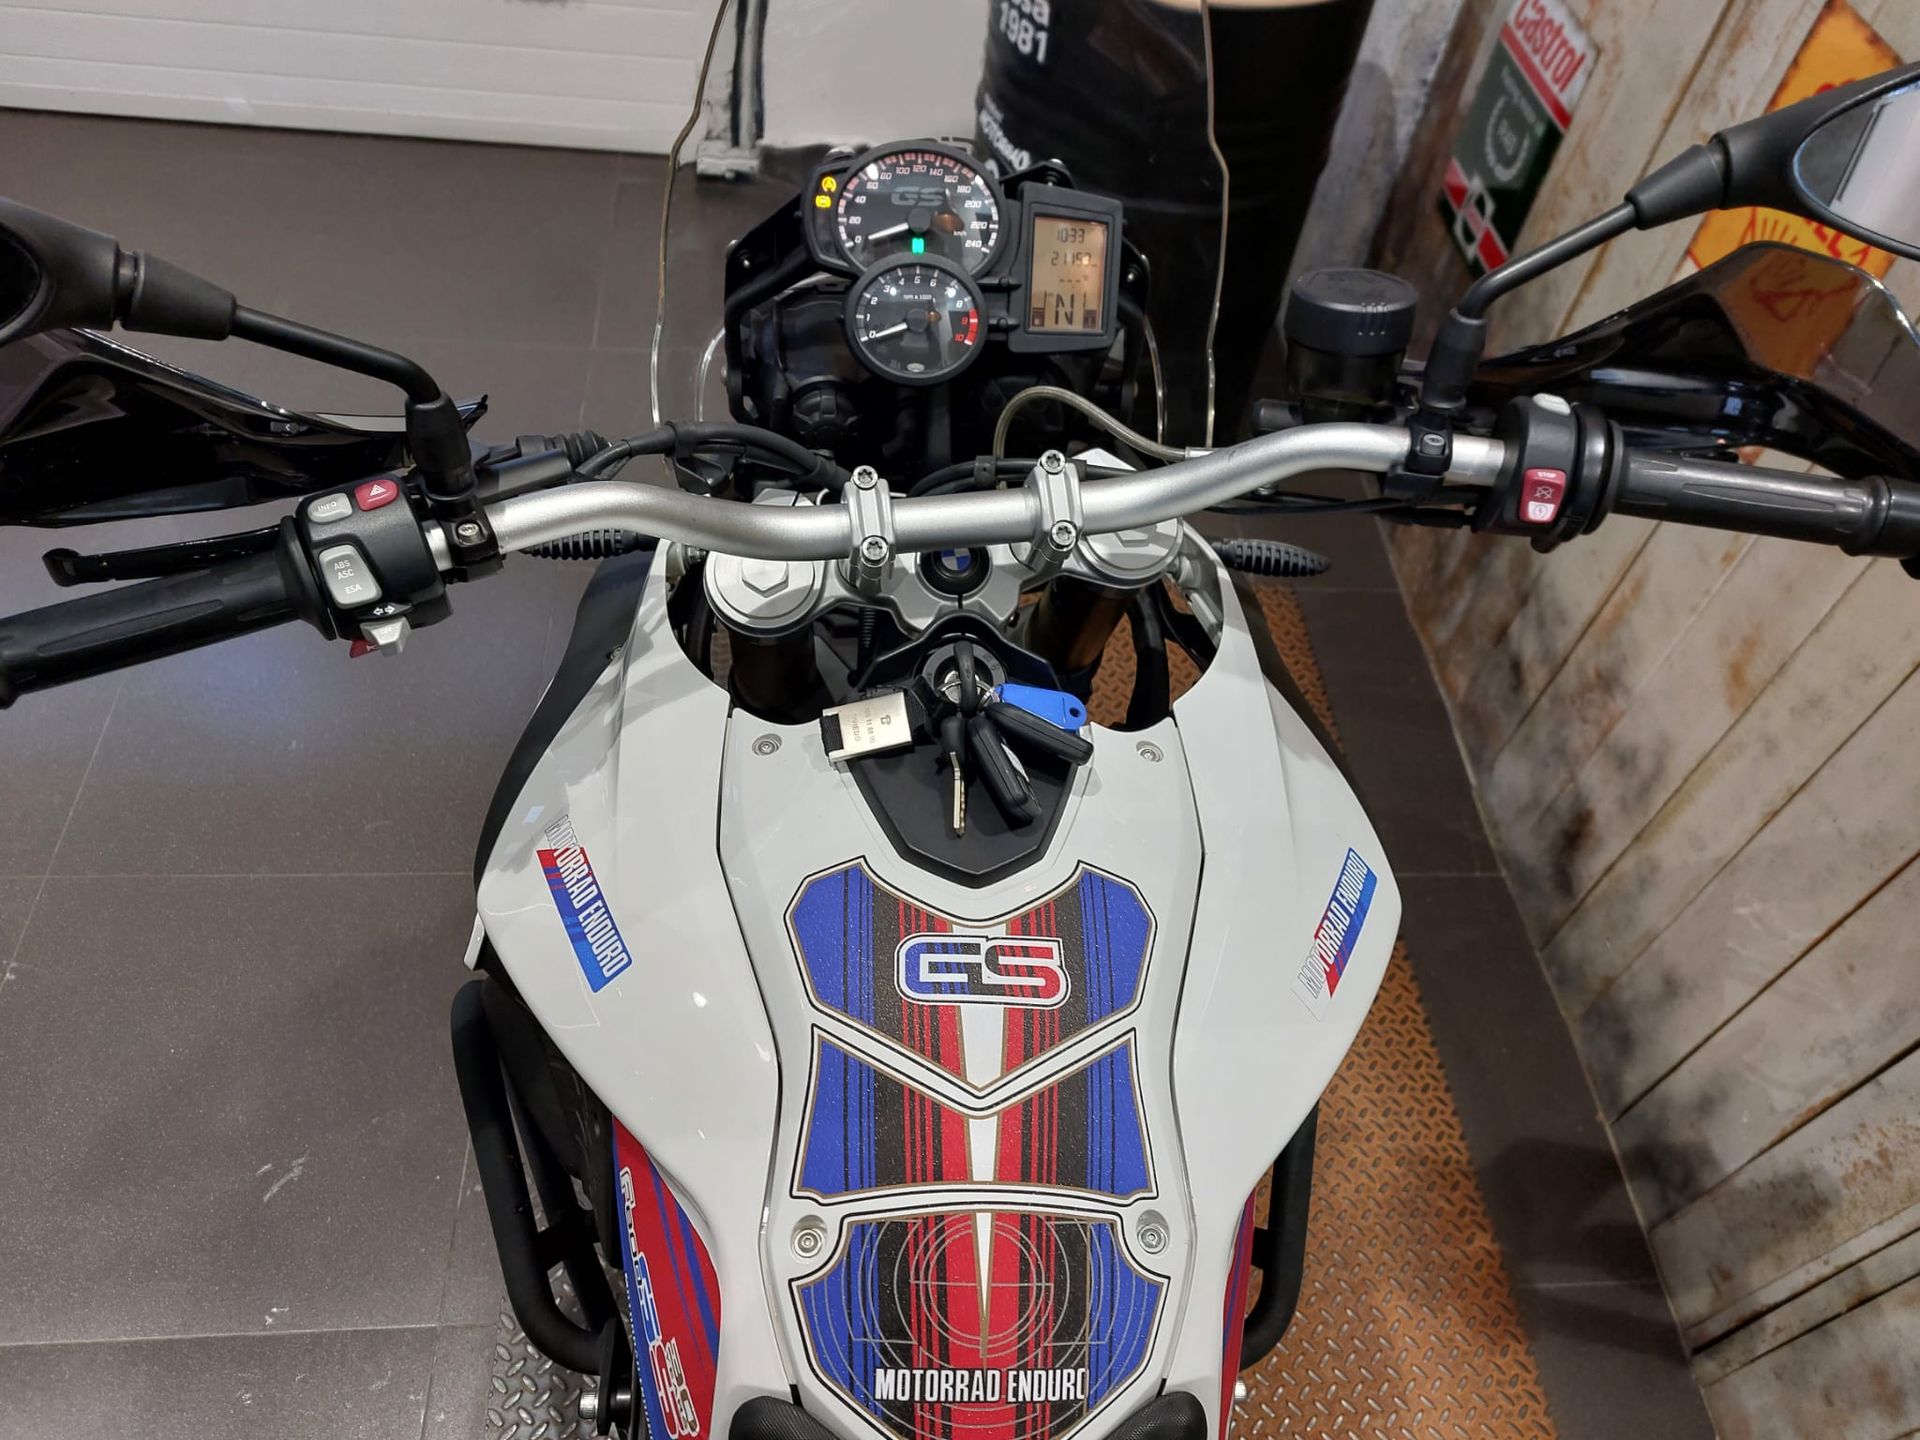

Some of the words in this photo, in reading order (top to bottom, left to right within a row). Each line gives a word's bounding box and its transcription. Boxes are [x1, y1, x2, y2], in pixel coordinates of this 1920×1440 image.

[1000, 2, 1048, 63] 1981
[896, 167, 911, 175] 100
[912, 165, 927, 173] 120
[929, 168, 944, 176] 140
[964, 200, 982, 208] 200
[965, 240, 982, 248] 240
[883, 285, 890, 293] 3
[870, 297, 878, 305] 2
[1055, 293, 1074, 325] N
[317, 501, 337, 512] INFO
[334, 559, 351, 571] ABS
[337, 569, 355, 580] ASC
[345, 584, 363, 595] ESA
[544, 814, 599, 910] MOTORRAD
[577, 900, 629, 979] ENDURO
[1297, 901, 1351, 999] MOTORRAD
[1336, 850, 1369, 915] ENDURO
[895, 934, 1070, 1008] GS
[875, 1369, 1001, 1402] MOTORRAD
[1007, 1368, 1089, 1402] ENDURO
